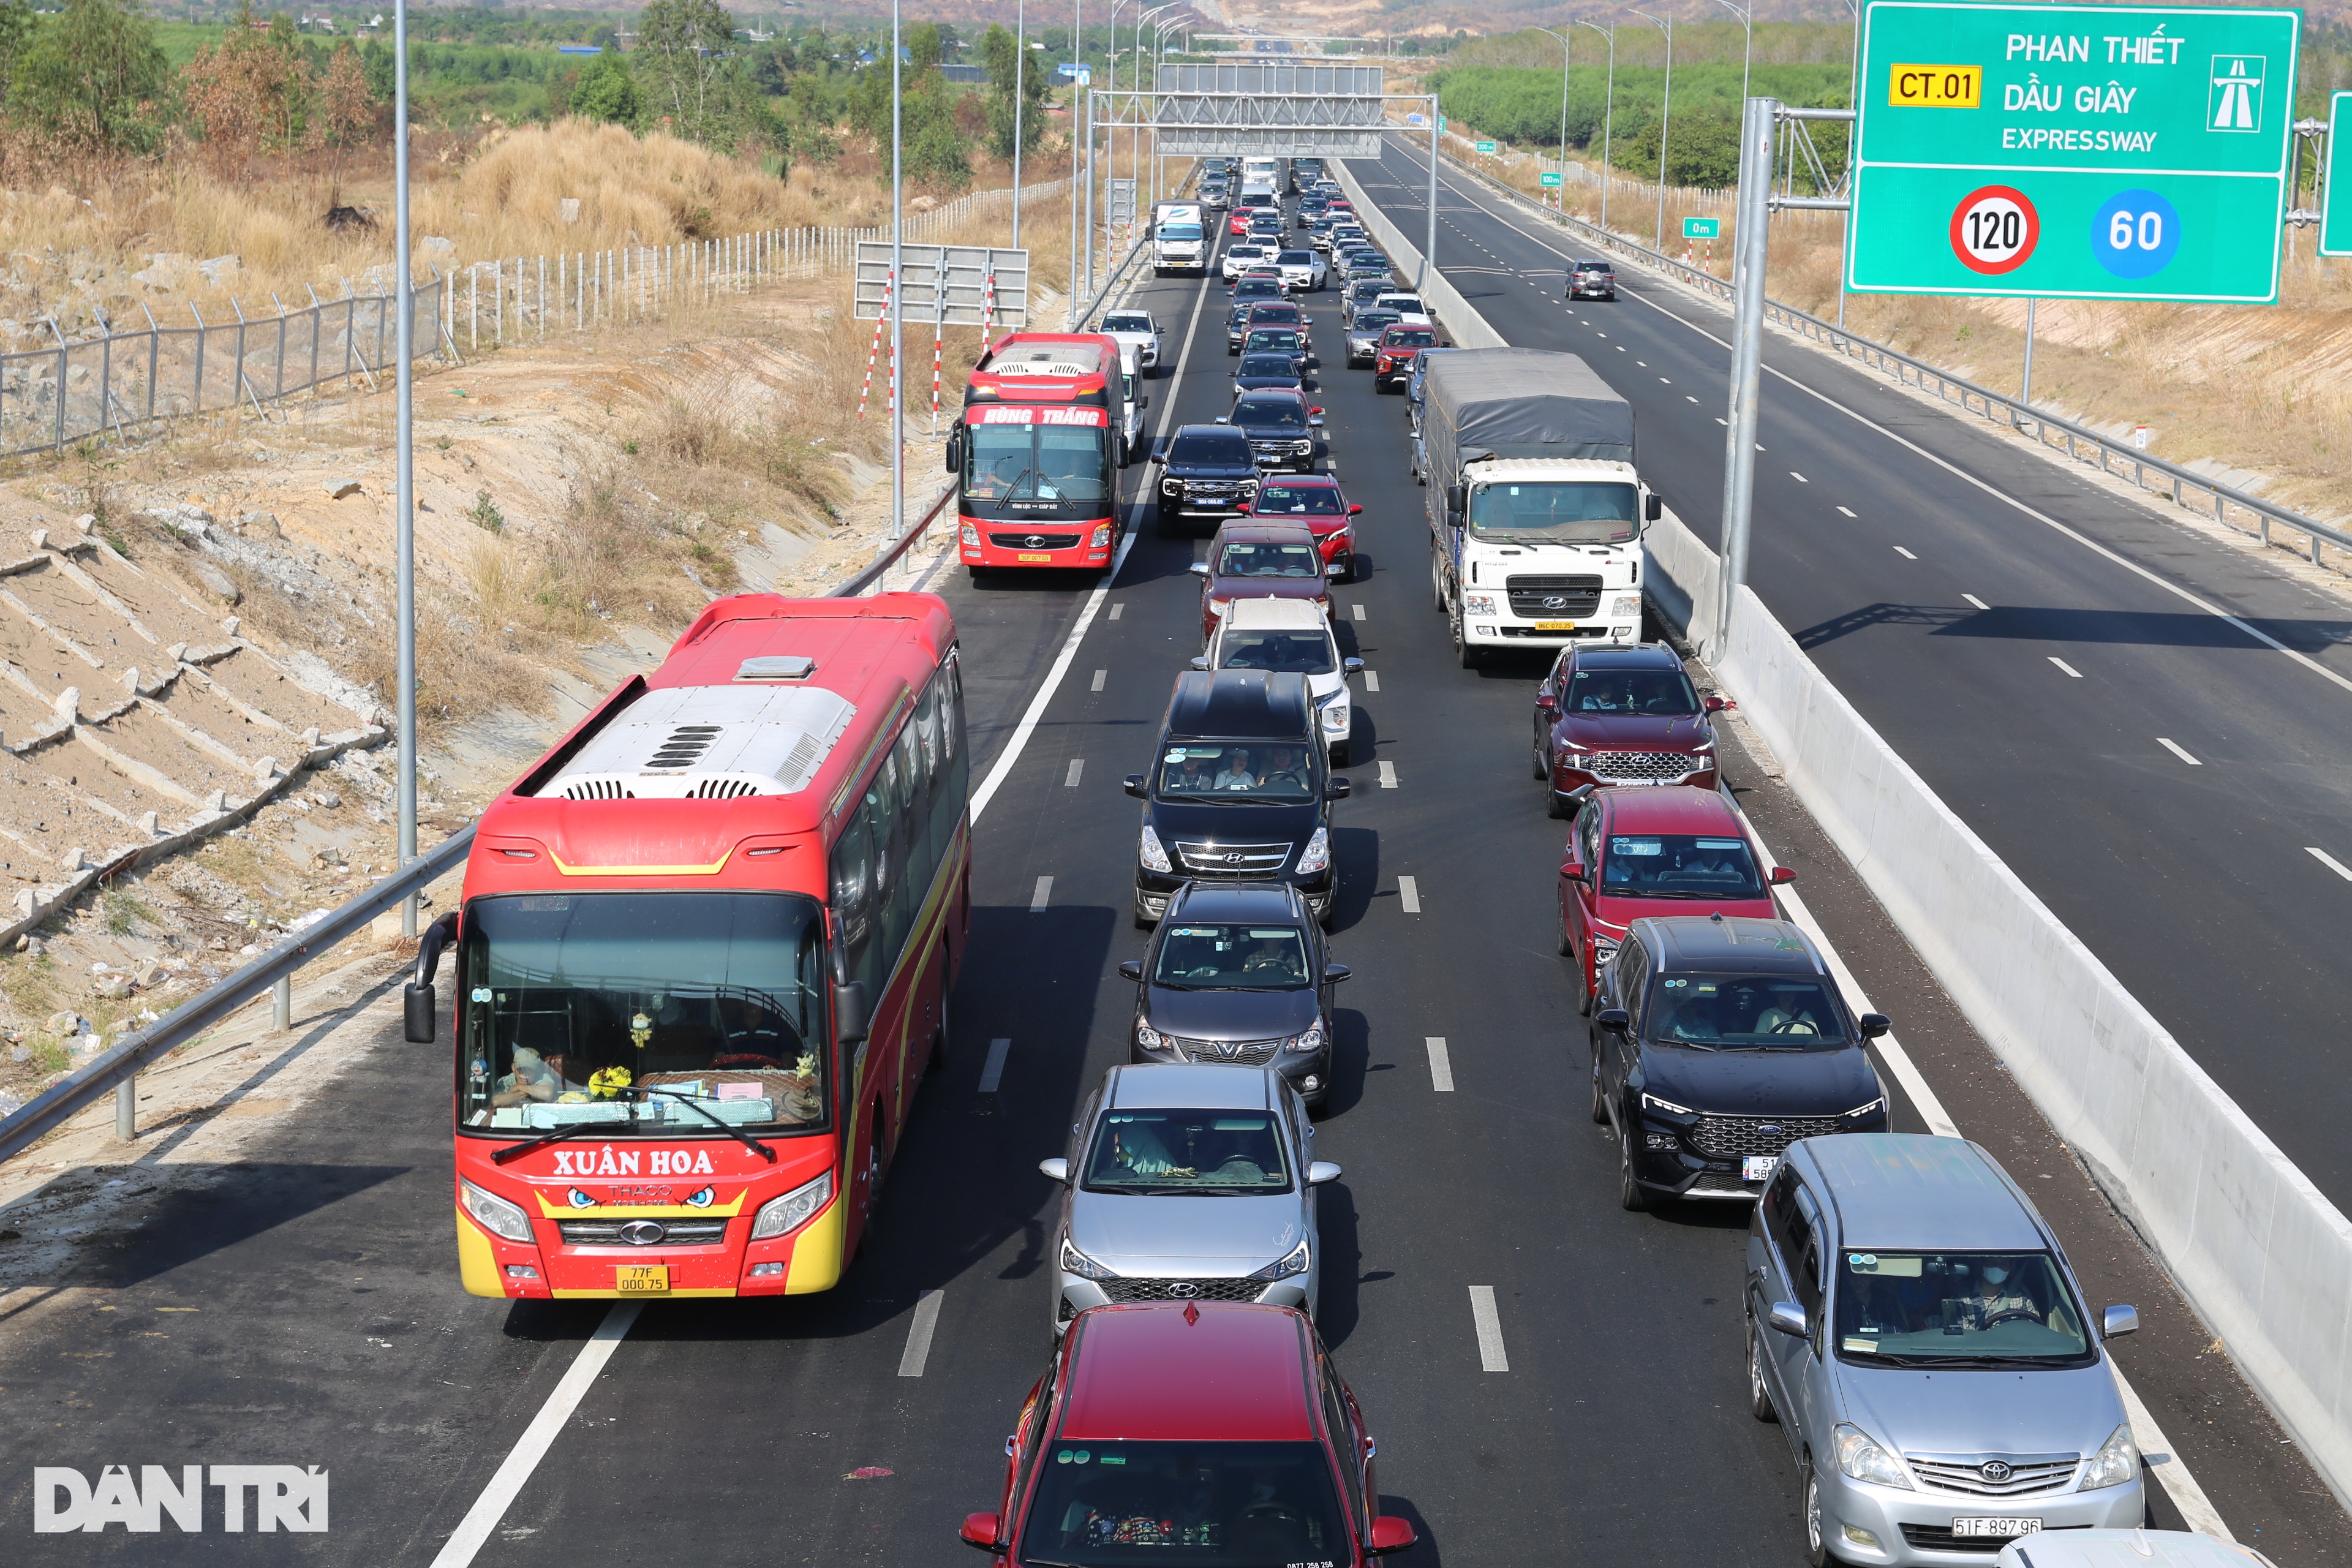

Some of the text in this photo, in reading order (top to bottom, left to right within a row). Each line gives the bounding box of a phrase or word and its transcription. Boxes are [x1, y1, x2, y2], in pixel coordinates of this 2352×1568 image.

[2005, 23, 2185, 65] PHAN THIẾT
[1899, 72, 1972, 99] CT.01
[2004, 72, 2137, 114] DẦU GIÂY
[2002, 129, 2158, 153] EXPRESSWAY
[1969, 211, 2019, 250] 120
[2109, 211, 2162, 250] 60
[983, 407, 1099, 426] HÙNG THẮNG
[553, 1144, 714, 1175] XUÂN HOA
[608, 1185, 673, 1196] THACO
[622, 1279, 662, 1289] 000.75
[631, 1268, 652, 1278] 77F
[1955, 1520, 2038, 1536] 51F-897.96
